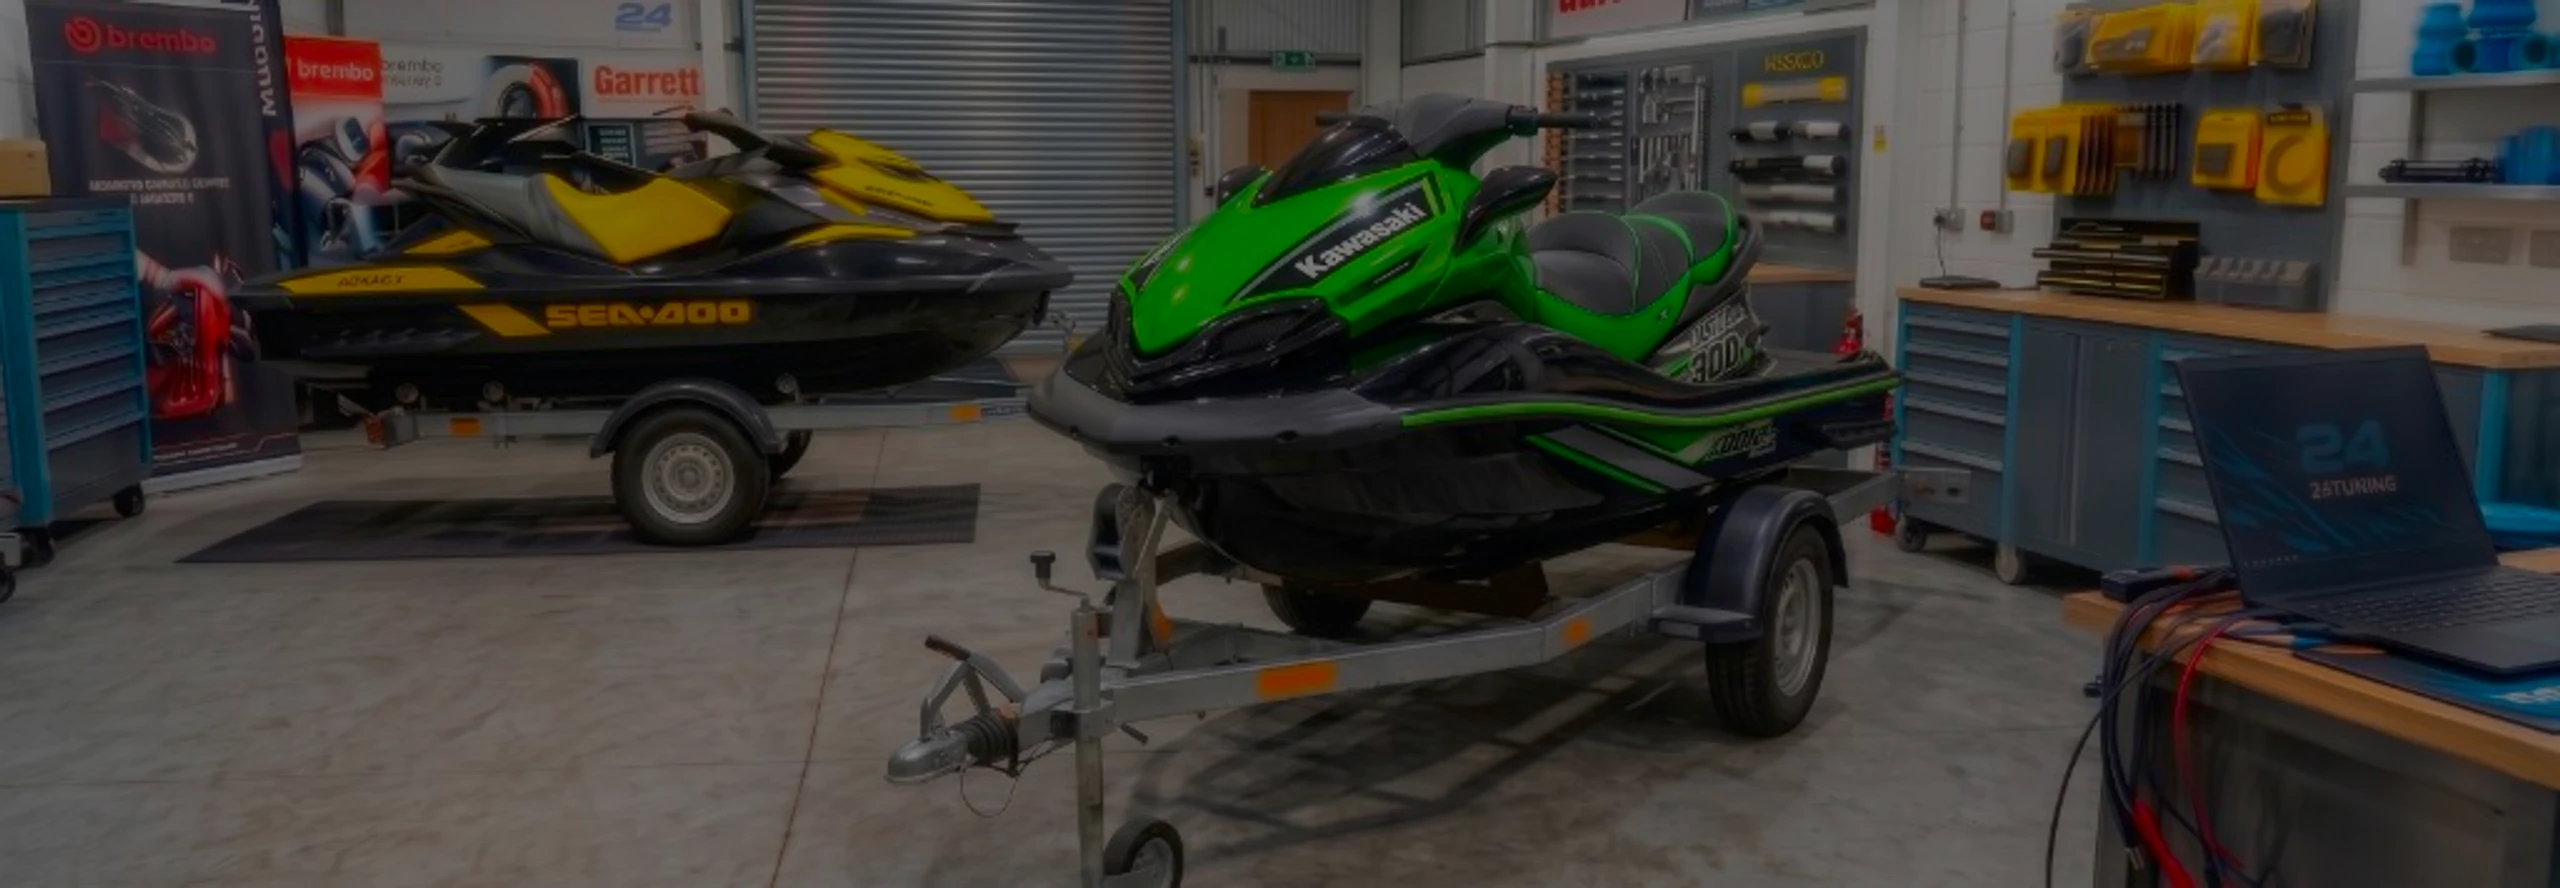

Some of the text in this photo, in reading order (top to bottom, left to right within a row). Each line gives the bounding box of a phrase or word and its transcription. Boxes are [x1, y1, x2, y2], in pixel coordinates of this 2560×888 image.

[615, 2, 672, 27] 24
[106, 24, 217, 53] brembo
[296, 57, 374, 82] brembo
[595, 65, 701, 96] Garrett
[1294, 202, 1428, 280] Kawasaki
[2296, 420, 2391, 474] 24
